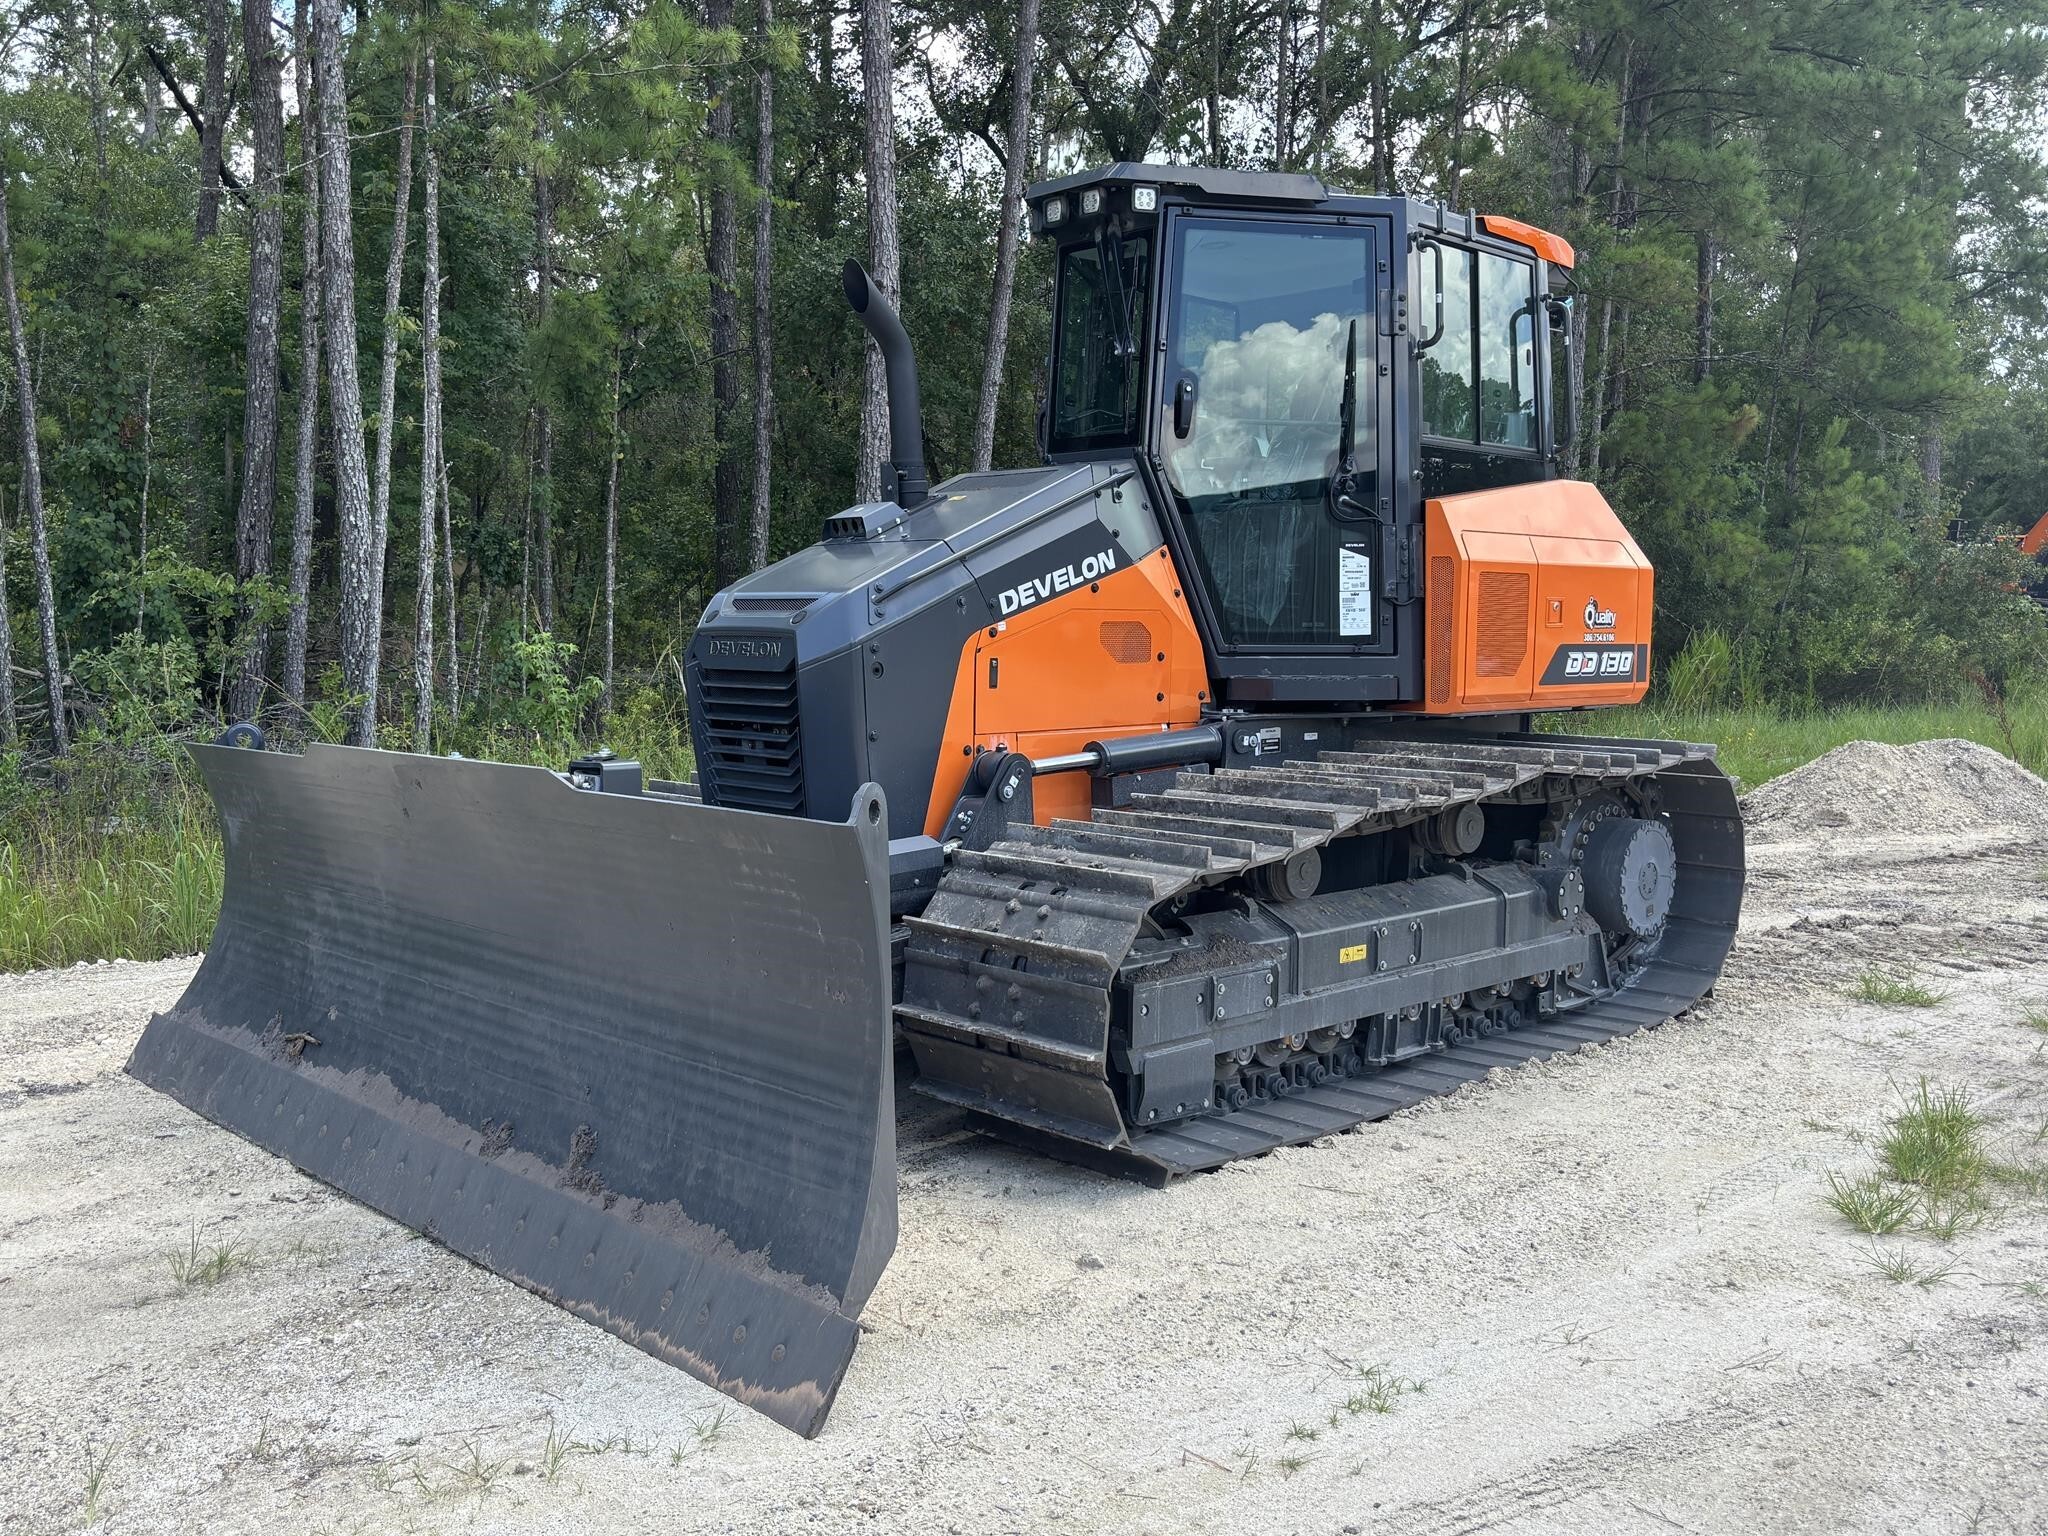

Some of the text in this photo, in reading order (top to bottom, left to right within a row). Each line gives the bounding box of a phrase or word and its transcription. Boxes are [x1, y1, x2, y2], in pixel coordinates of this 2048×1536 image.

[998, 548, 1117, 615] DEVELON
[1584, 598, 1617, 629] Quality
[709, 640, 782, 657] DEVELON
[1565, 651, 1634, 677] DD 130
